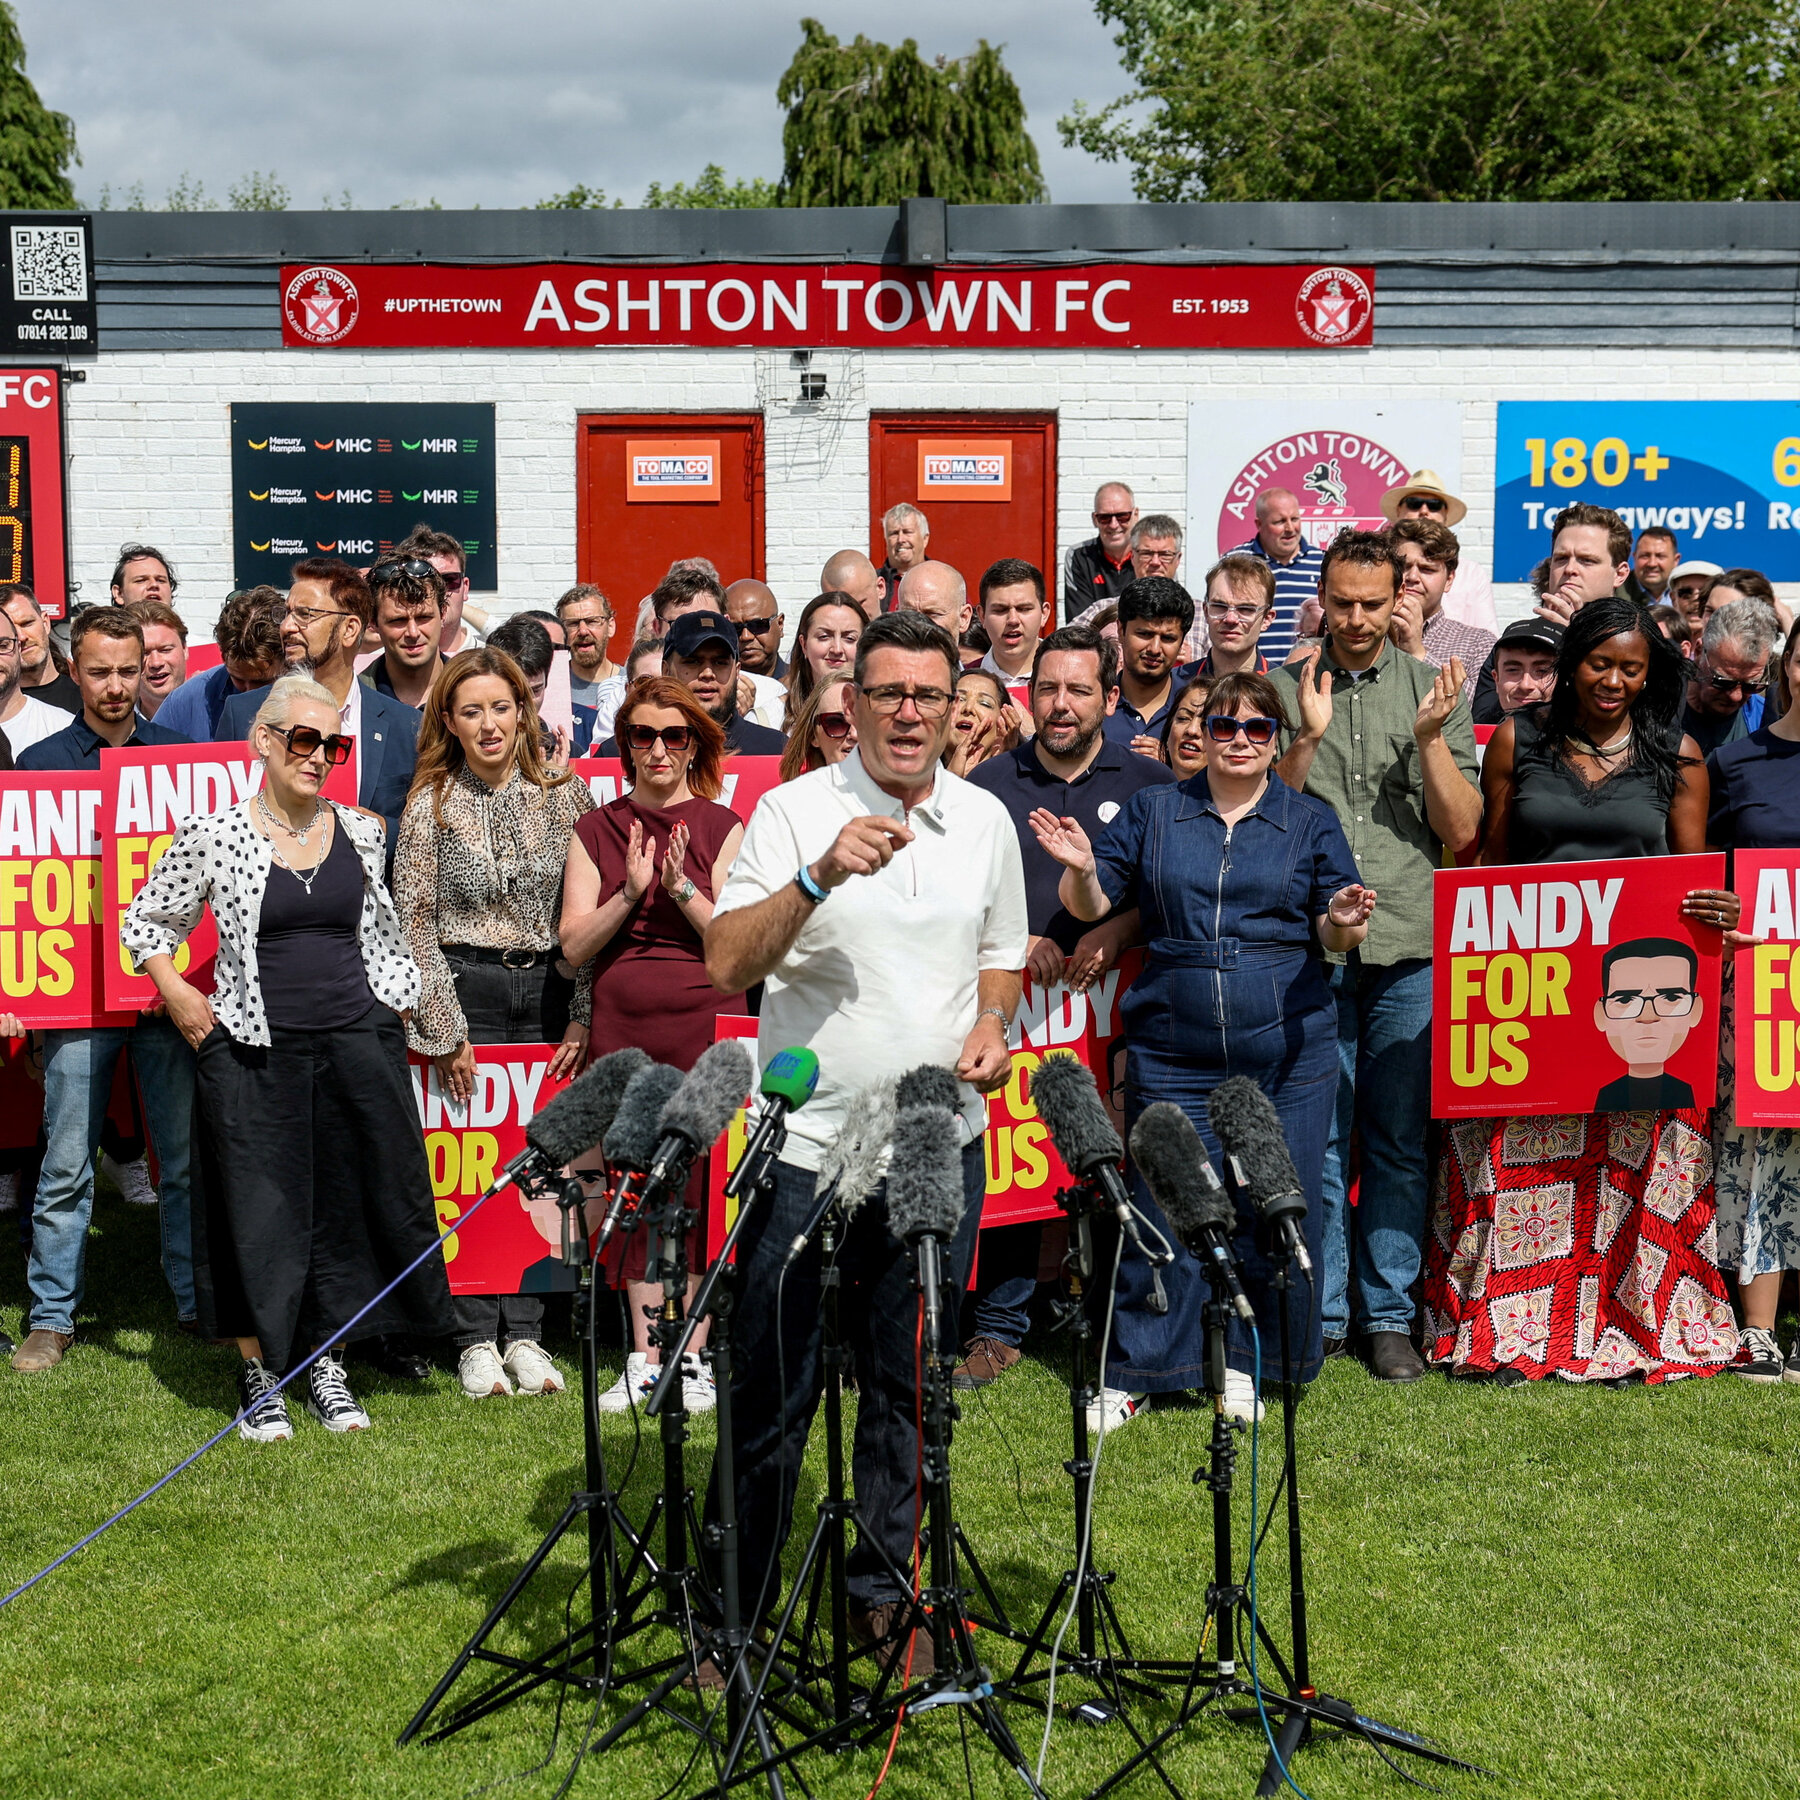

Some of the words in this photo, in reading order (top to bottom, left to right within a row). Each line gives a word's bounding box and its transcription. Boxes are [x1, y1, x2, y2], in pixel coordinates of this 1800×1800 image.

[289, 270, 319, 301] ASHTON
[320, 270, 349, 290] TOWN
[345, 288, 356, 302] FC
[1299, 271, 1333, 302] ASHTON
[1333, 271, 1361, 291] TOWN
[384, 298, 502, 313] #UPTHETOWN
[523, 279, 808, 332] ASHTON
[822, 279, 1032, 332] TOWN
[1055, 279, 1131, 333] FC
[1171, 299, 1207, 314] EST.
[1210, 299, 1250, 314] 1953
[32, 308, 72, 321] CALL
[17, 325, 48, 340] 07814
[49, 325, 68, 340] 282
[69, 325, 88, 340] 109
[0, 375, 51, 409] FC
[269, 436, 301, 446] Mercury
[336, 438, 372, 453] MHC
[422, 438, 458, 453] MHR
[269, 444, 306, 454] Hampton
[638, 461, 708, 474] TOMACO
[929, 460, 999, 473] TOMACO
[1525, 437, 1670, 488] 180+
[1227, 433, 1319, 521] ASHTON
[1323, 433, 1405, 487] TOWN
[270, 487, 303, 497] Mercury
[336, 489, 373, 503] MHC
[423, 489, 458, 504] MHR
[270, 496, 307, 505] Hampton
[1522, 500, 1746, 539] Taaways!
[271, 538, 303, 548] Mercury
[338, 540, 374, 554] MHC
[271, 546, 308, 556] Hampton
[1449, 878, 1625, 953] ANDY
[0, 929, 76, 998] US
[1450, 952, 1572, 1020] FOR
[1008, 969, 1121, 1050] NDY
[1450, 1021, 1531, 1088] US
[424, 1131, 499, 1198] OR
[984, 1122, 1049, 1195] US
